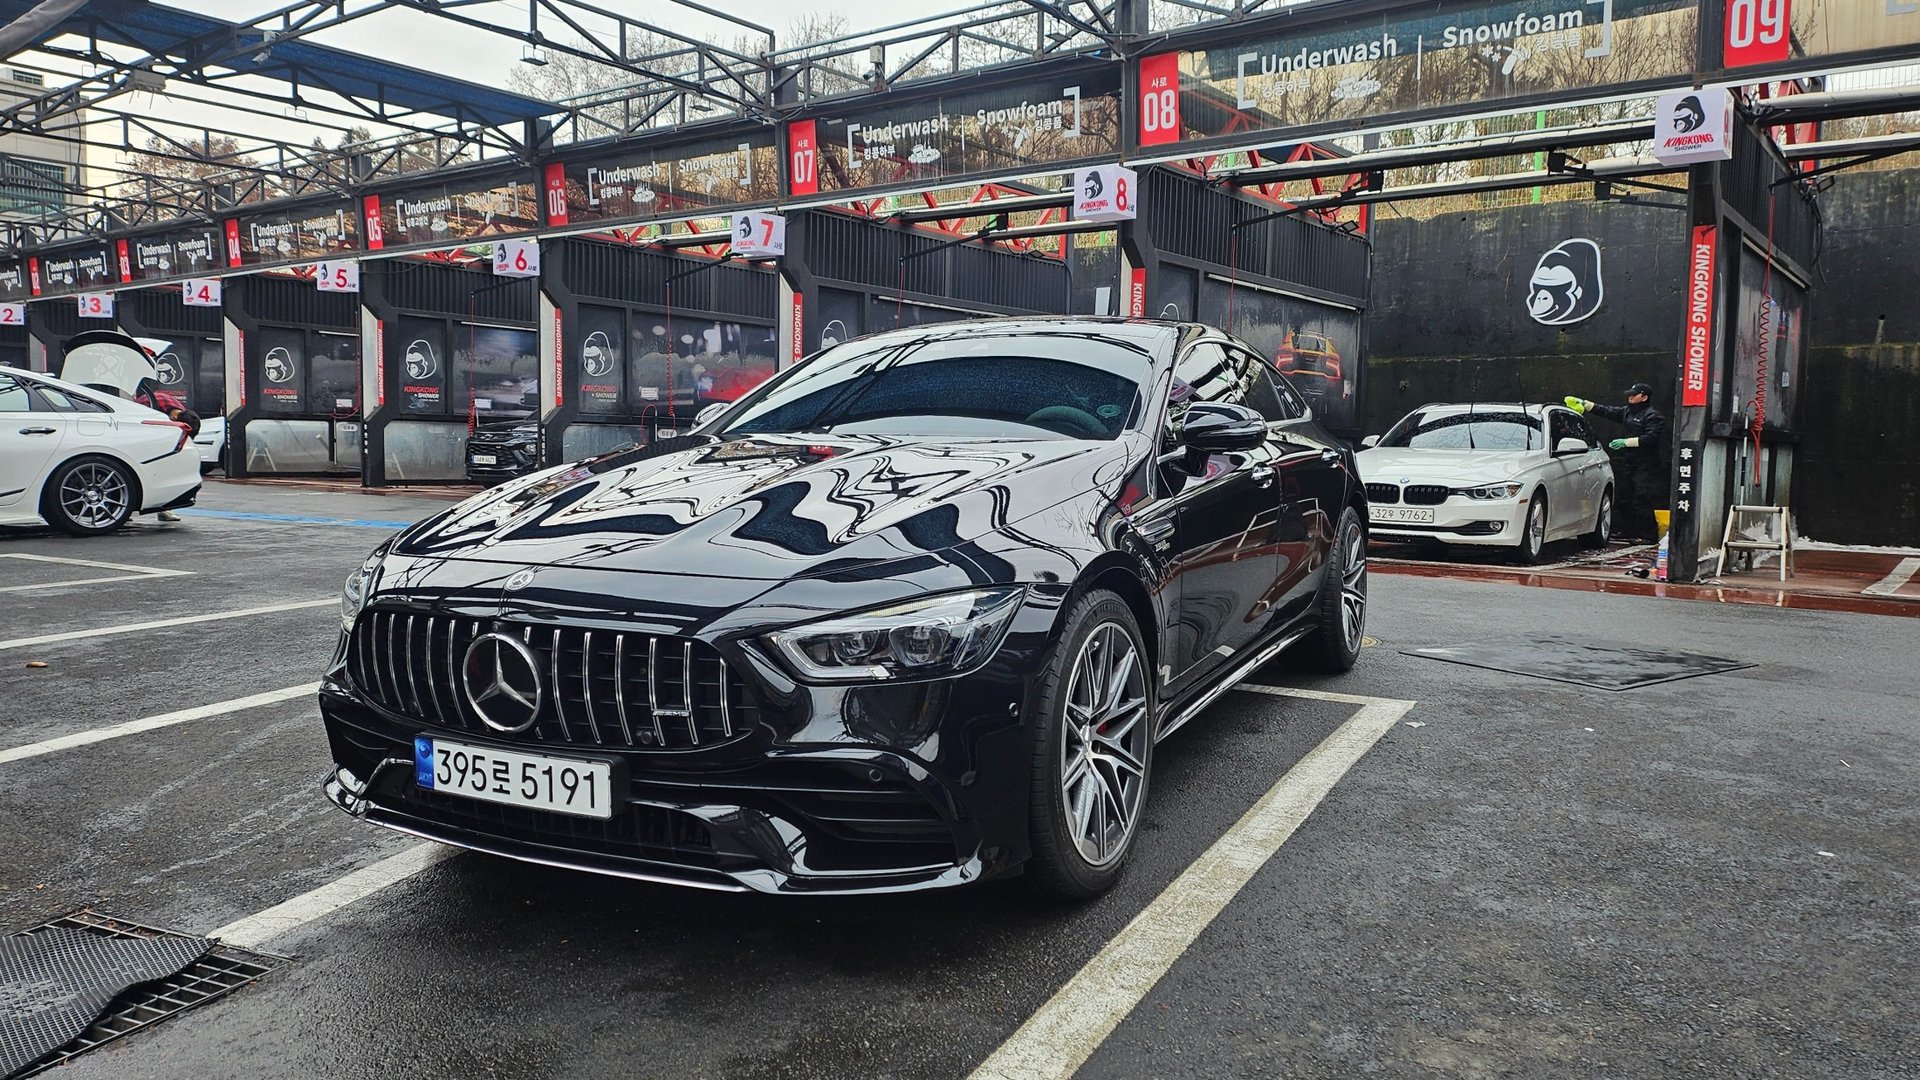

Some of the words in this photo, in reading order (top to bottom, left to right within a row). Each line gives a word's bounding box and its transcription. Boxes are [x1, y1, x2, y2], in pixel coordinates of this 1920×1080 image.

[1730, 0, 1784, 48] 09
[1261, 33, 1397, 76] Underwash
[1443, 9, 1583, 48] Snowfoam
[1152, 77, 1168, 88] 사로
[1144, 89, 1176, 132] 08
[862, 116, 949, 144] Underwash
[976, 100, 1063, 126] Snowfoam
[1034, 117, 1062, 131] 킹콩폼
[1664, 133, 1714, 148] KINGKONG
[1674, 144, 1702, 152] SHOWER
[863, 144, 896, 160] 킹콩하부
[599, 161, 659, 184] Underwash
[679, 153, 738, 173] Snowfoam
[793, 150, 814, 184] 07
[549, 188, 566, 216] 06
[1116, 177, 1127, 211] 8
[404, 197, 451, 216] Underwash
[1079, 199, 1109, 211] KINGKONG
[257, 221, 293, 237] Underwash
[302, 217, 338, 231] Snowfoam
[367, 216, 382, 241] 05
[761, 219, 774, 247] 7
[142, 242, 172, 257] Underwash
[178, 239, 206, 251] Snowfoam
[229, 238, 241, 260] 04
[120, 256, 130, 275] 03
[515, 248, 527, 271] 6
[335, 269, 347, 288] 5
[1692, 244, 1710, 323] KINGKONG
[198, 285, 210, 302] 4
[3, 308, 13, 322] 2
[90, 297, 101, 313] 3
[1688, 326, 1706, 391] SHOWER
[581, 384, 617, 393] KINGKONG
[1678, 447, 1693, 512] 후면주차
[1400, 509, 1427, 521] 9762
[436, 749, 511, 795] 395로
[521, 762, 595, 808] 5191
